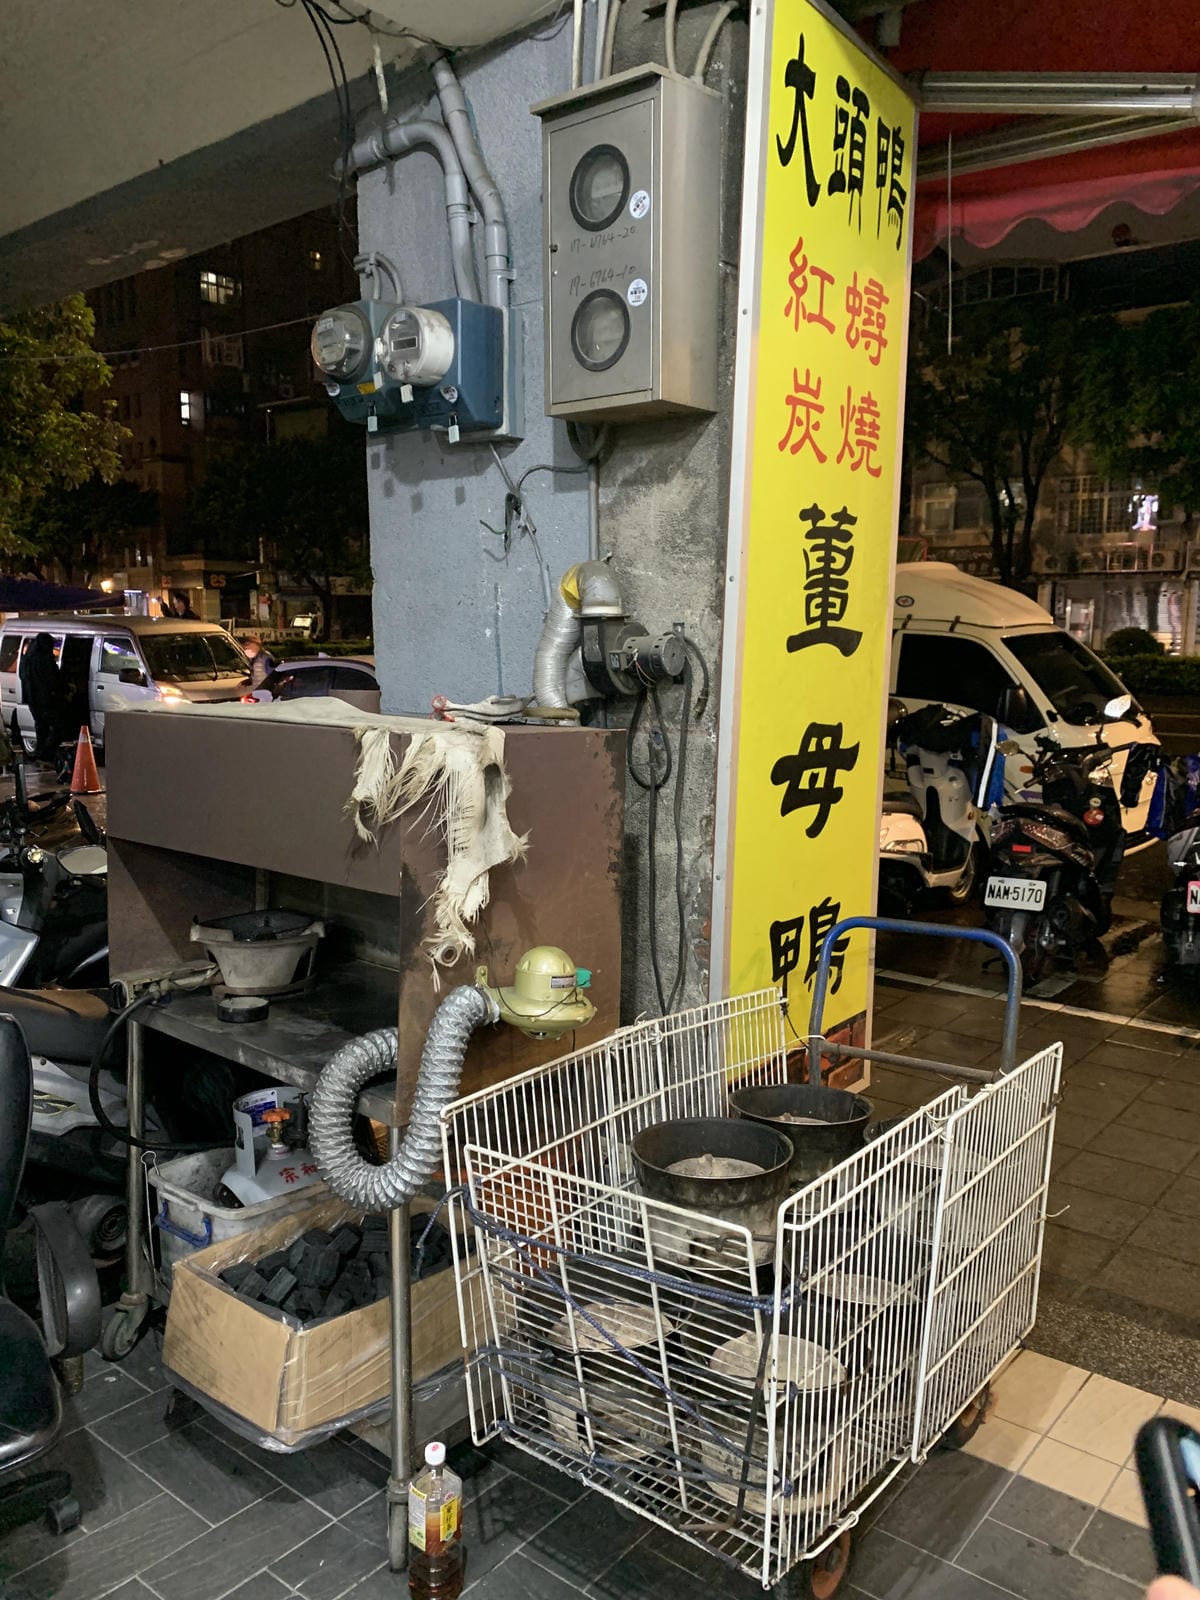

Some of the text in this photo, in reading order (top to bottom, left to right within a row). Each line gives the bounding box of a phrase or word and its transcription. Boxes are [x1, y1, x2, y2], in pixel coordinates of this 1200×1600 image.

[776, 32, 907, 250] 大頭鴨
[784, 236, 890, 366] 紅蟳
[778, 367, 882, 478] 炭燒
[987, 883, 1044, 904] NAM-5170
